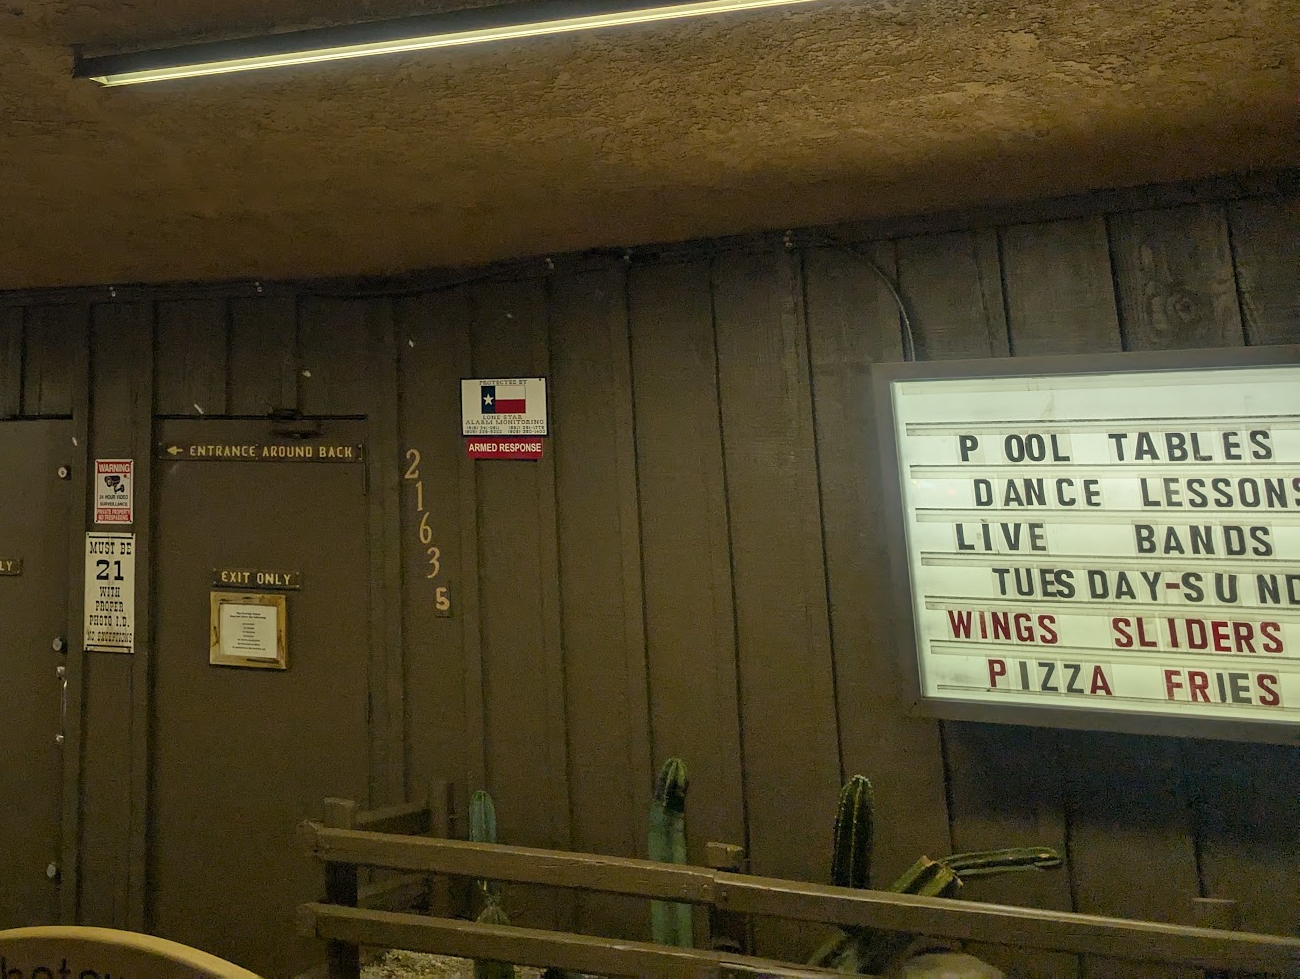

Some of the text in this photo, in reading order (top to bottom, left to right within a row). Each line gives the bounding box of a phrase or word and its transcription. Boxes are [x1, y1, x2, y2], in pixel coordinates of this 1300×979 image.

[190, 445, 353, 458] ENTRANCE AROUND BACK
[469, 443, 541, 452] ARMED RESPONSE
[1108, 430, 1273, 461] TABLES
[98, 463, 130, 472] WARNING
[973, 478, 1102, 507] DANCE
[955, 522, 1273, 556] LIVE BANDS
[90, 542, 132, 555] MUST BE
[96, 560, 124, 581] 21
[221, 571, 291, 585] EXIT ONLY
[99, 586, 120, 598] WITH
[95, 601, 124, 612] PROPER
[89, 615, 112, 627] PHOTO
[948, 610, 1283, 654] WINGS SLIDERS
[988, 659, 1280, 706] PIZZA FRIES
